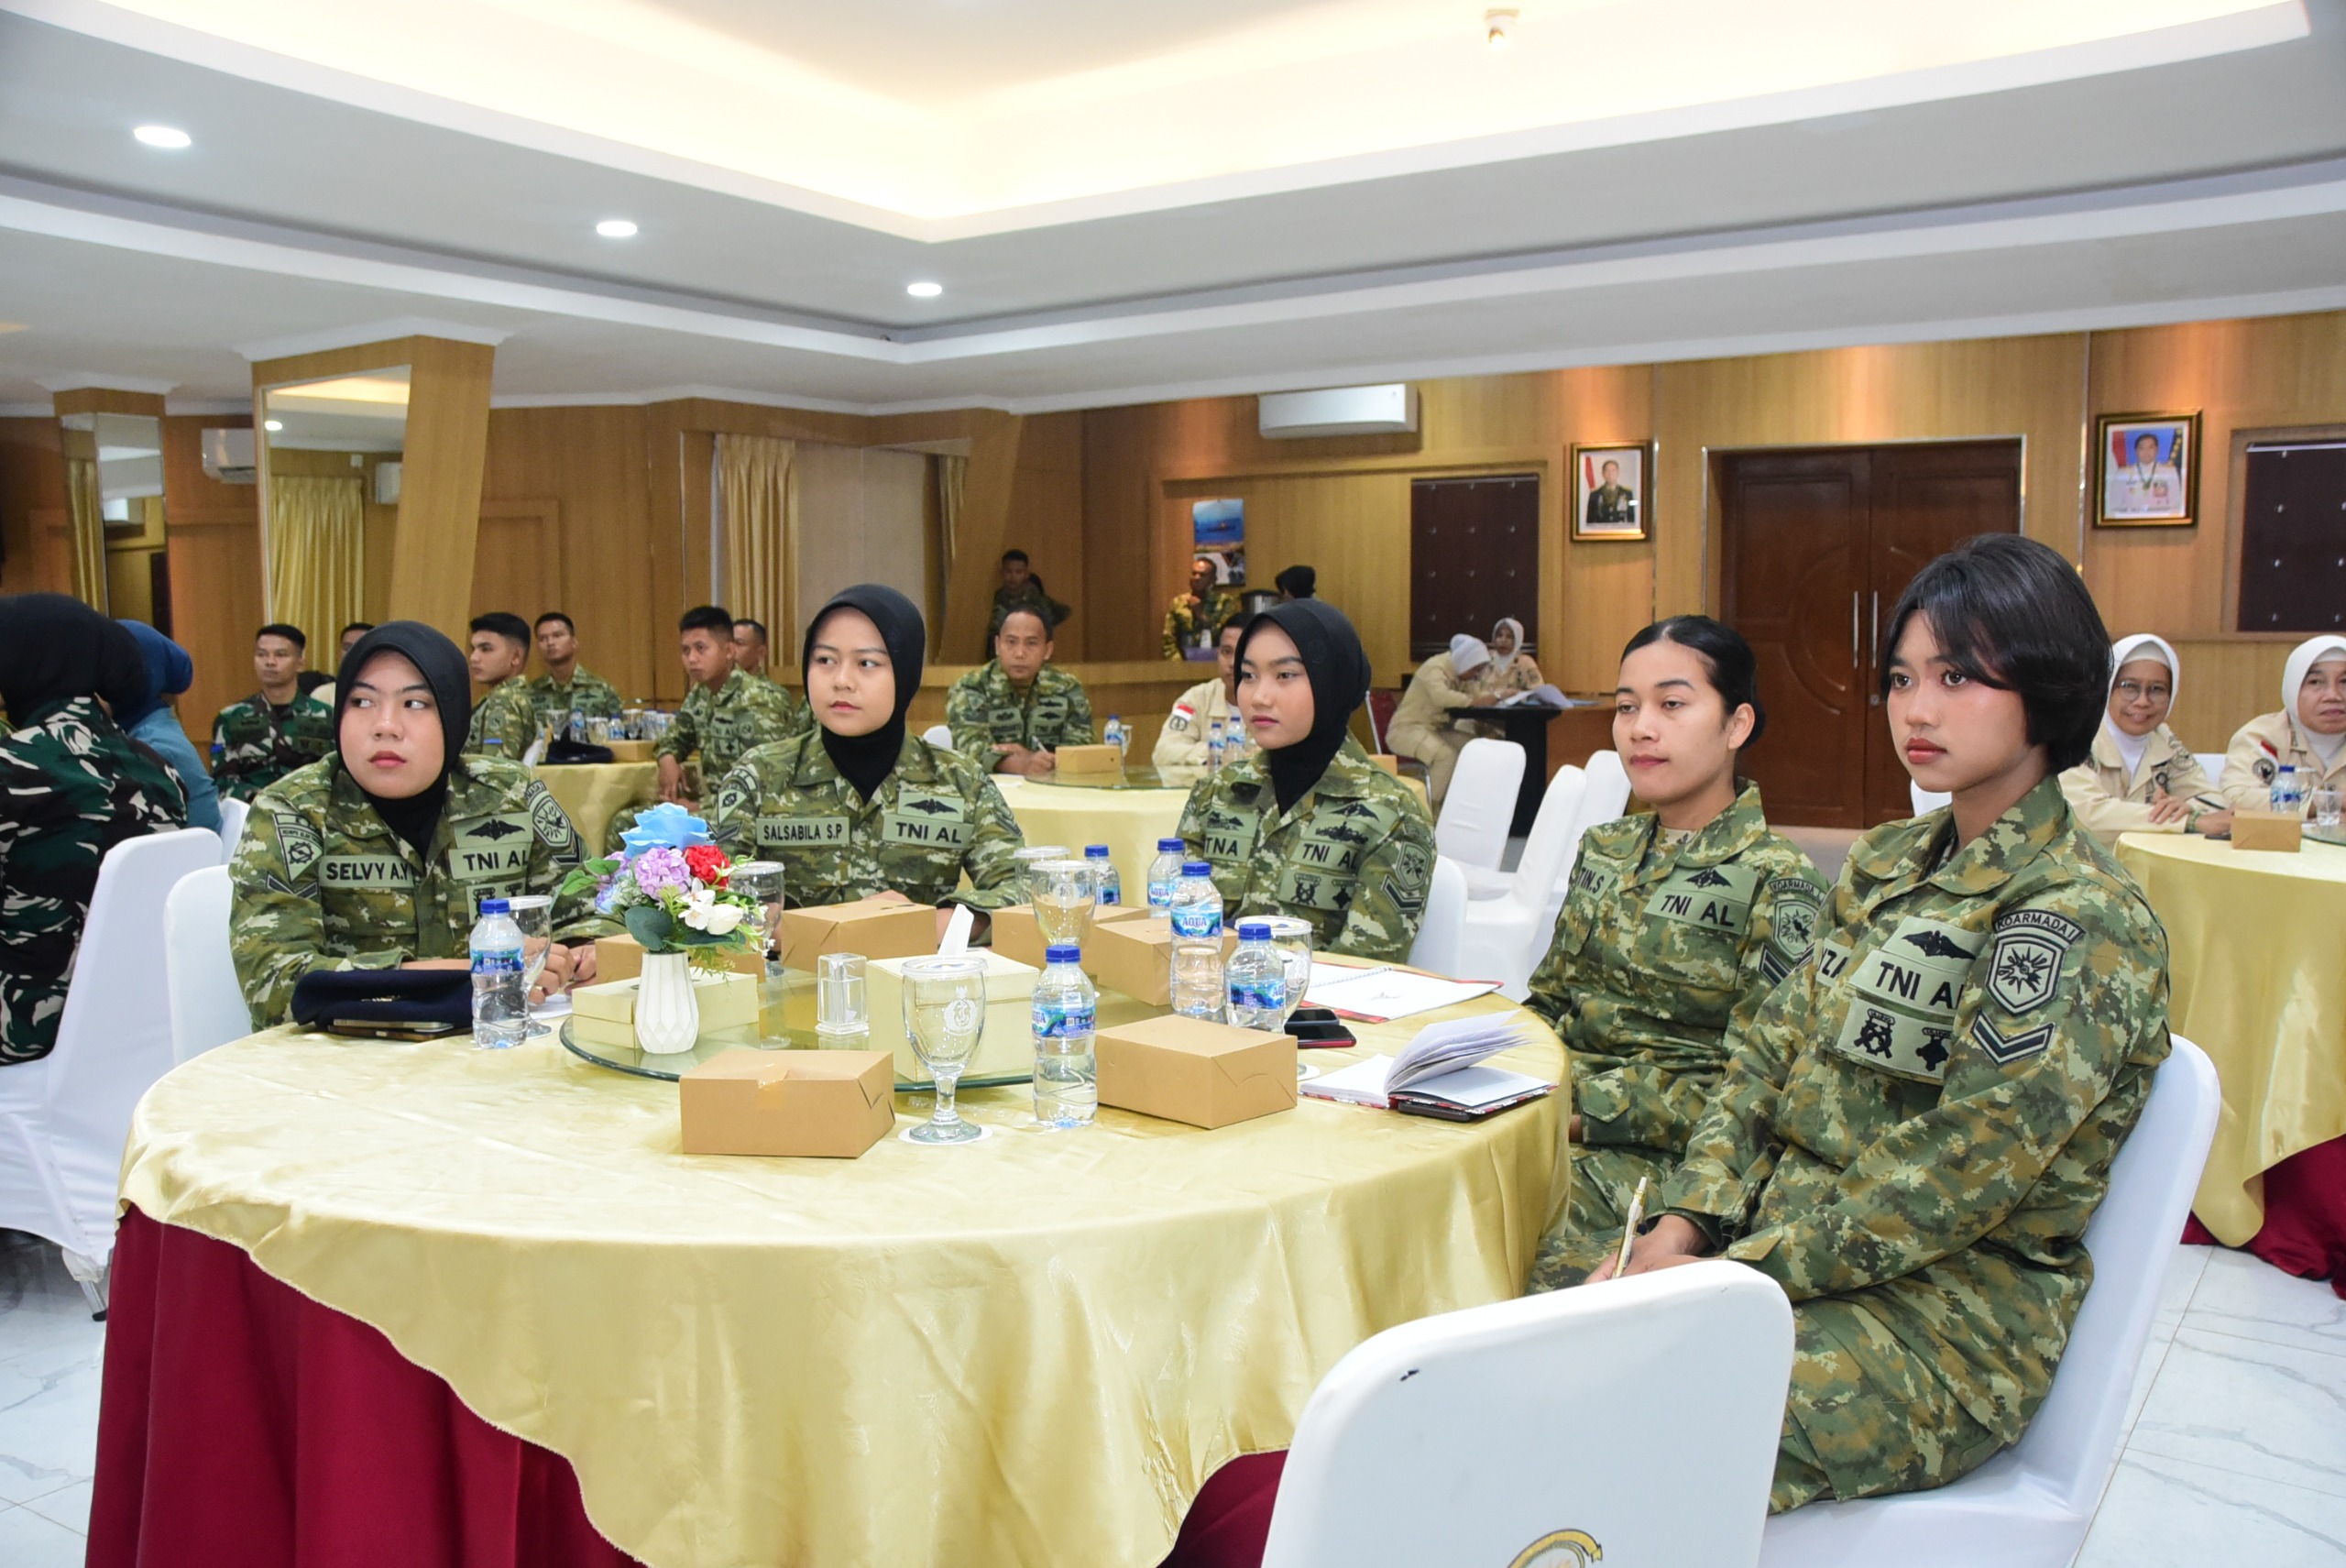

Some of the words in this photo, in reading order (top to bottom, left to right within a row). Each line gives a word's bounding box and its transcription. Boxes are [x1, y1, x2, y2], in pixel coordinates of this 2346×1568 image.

[763, 824, 821, 840] SALSABILA
[827, 823, 842, 839] S.P
[895, 821, 928, 840] TNI
[936, 827, 962, 844] AL
[462, 851, 499, 872] TNI
[1302, 843, 1331, 863] TNI
[326, 861, 386, 881] SELVY
[1660, 894, 1693, 916] TNI
[1699, 901, 1735, 927] AL
[1182, 916, 1208, 927] AQUA
[1996, 913, 2067, 936] KOARMADA
[2068, 927, 2076, 938] I
[1875, 960, 1922, 1001] TNI
